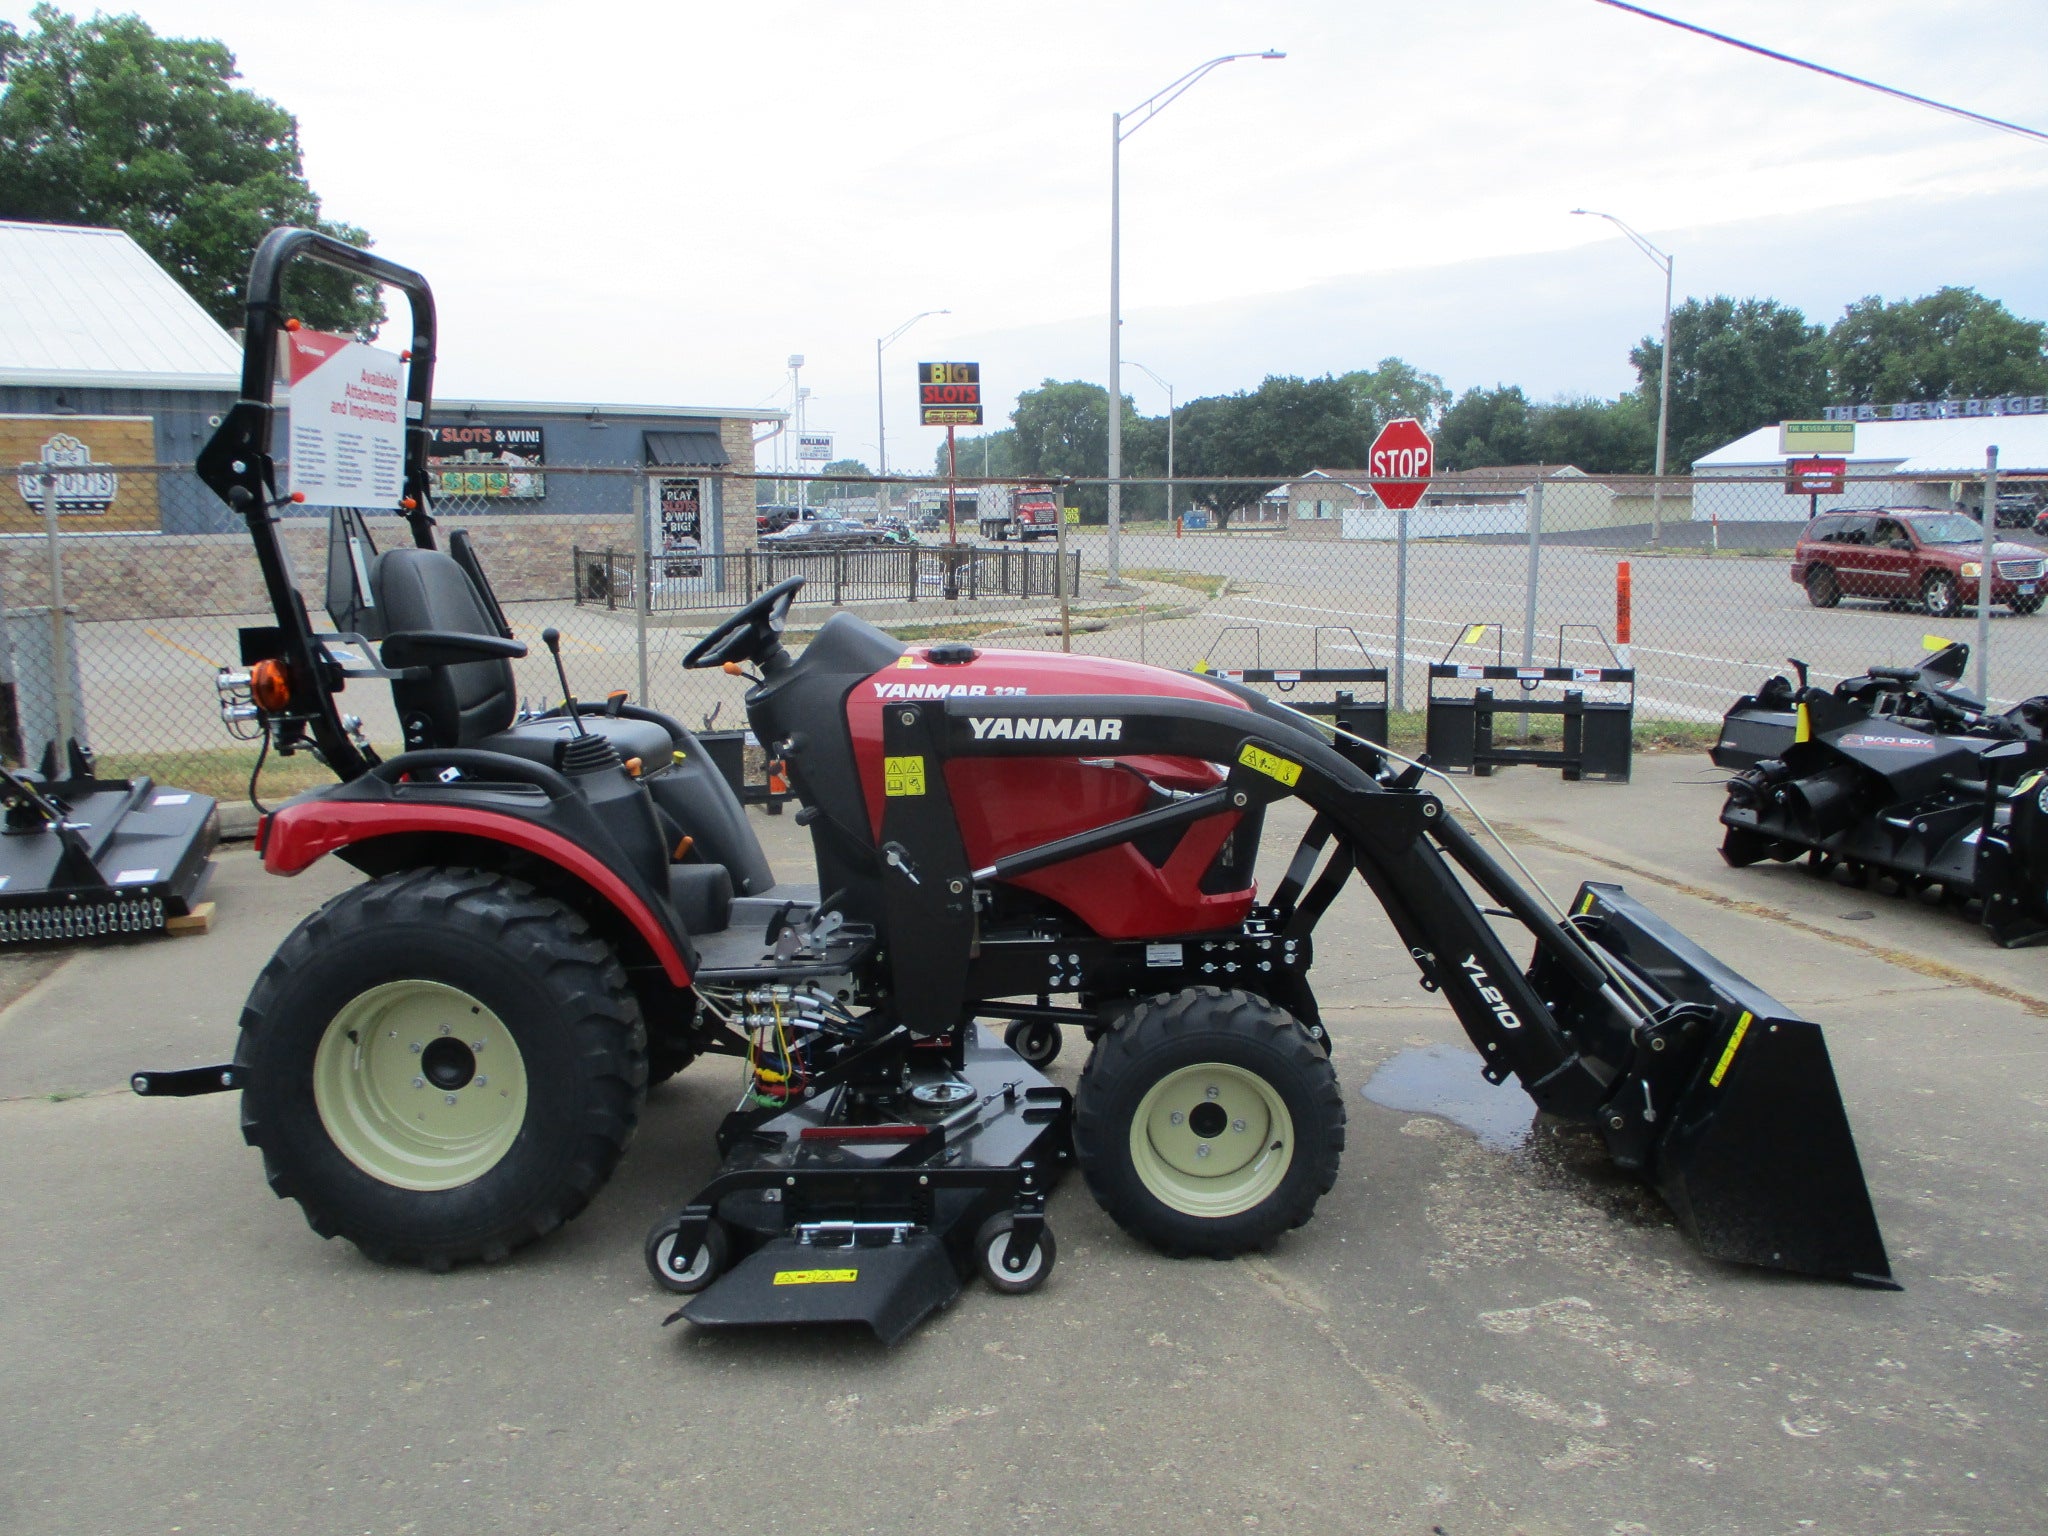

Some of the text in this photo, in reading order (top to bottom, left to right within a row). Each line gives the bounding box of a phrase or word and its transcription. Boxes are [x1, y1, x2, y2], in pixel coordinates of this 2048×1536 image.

[361, 368, 398, 390] Available
[931, 363, 969, 384] BIG
[345, 382, 397, 407] Attachments
[923, 385, 977, 403] SLOTS
[331, 400, 397, 423] and Implements
[1822, 405, 1871, 421] THE
[441, 428, 492, 443] SLOTS
[495, 430, 505, 442] &
[507, 431, 540, 443] WIN!
[54, 452, 77, 461] BIG
[1374, 447, 1428, 478] STOP
[667, 491, 692, 501] PLAY
[662, 501, 698, 512] SLOTS
[675, 512, 696, 521] WIN
[670, 522, 691, 532] BIG!
[873, 683, 987, 699] YANMAR
[968, 717, 1123, 741] YANMAR
[1864, 735, 1932, 745] BAD BOY
[1461, 953, 1521, 1029] YL210
